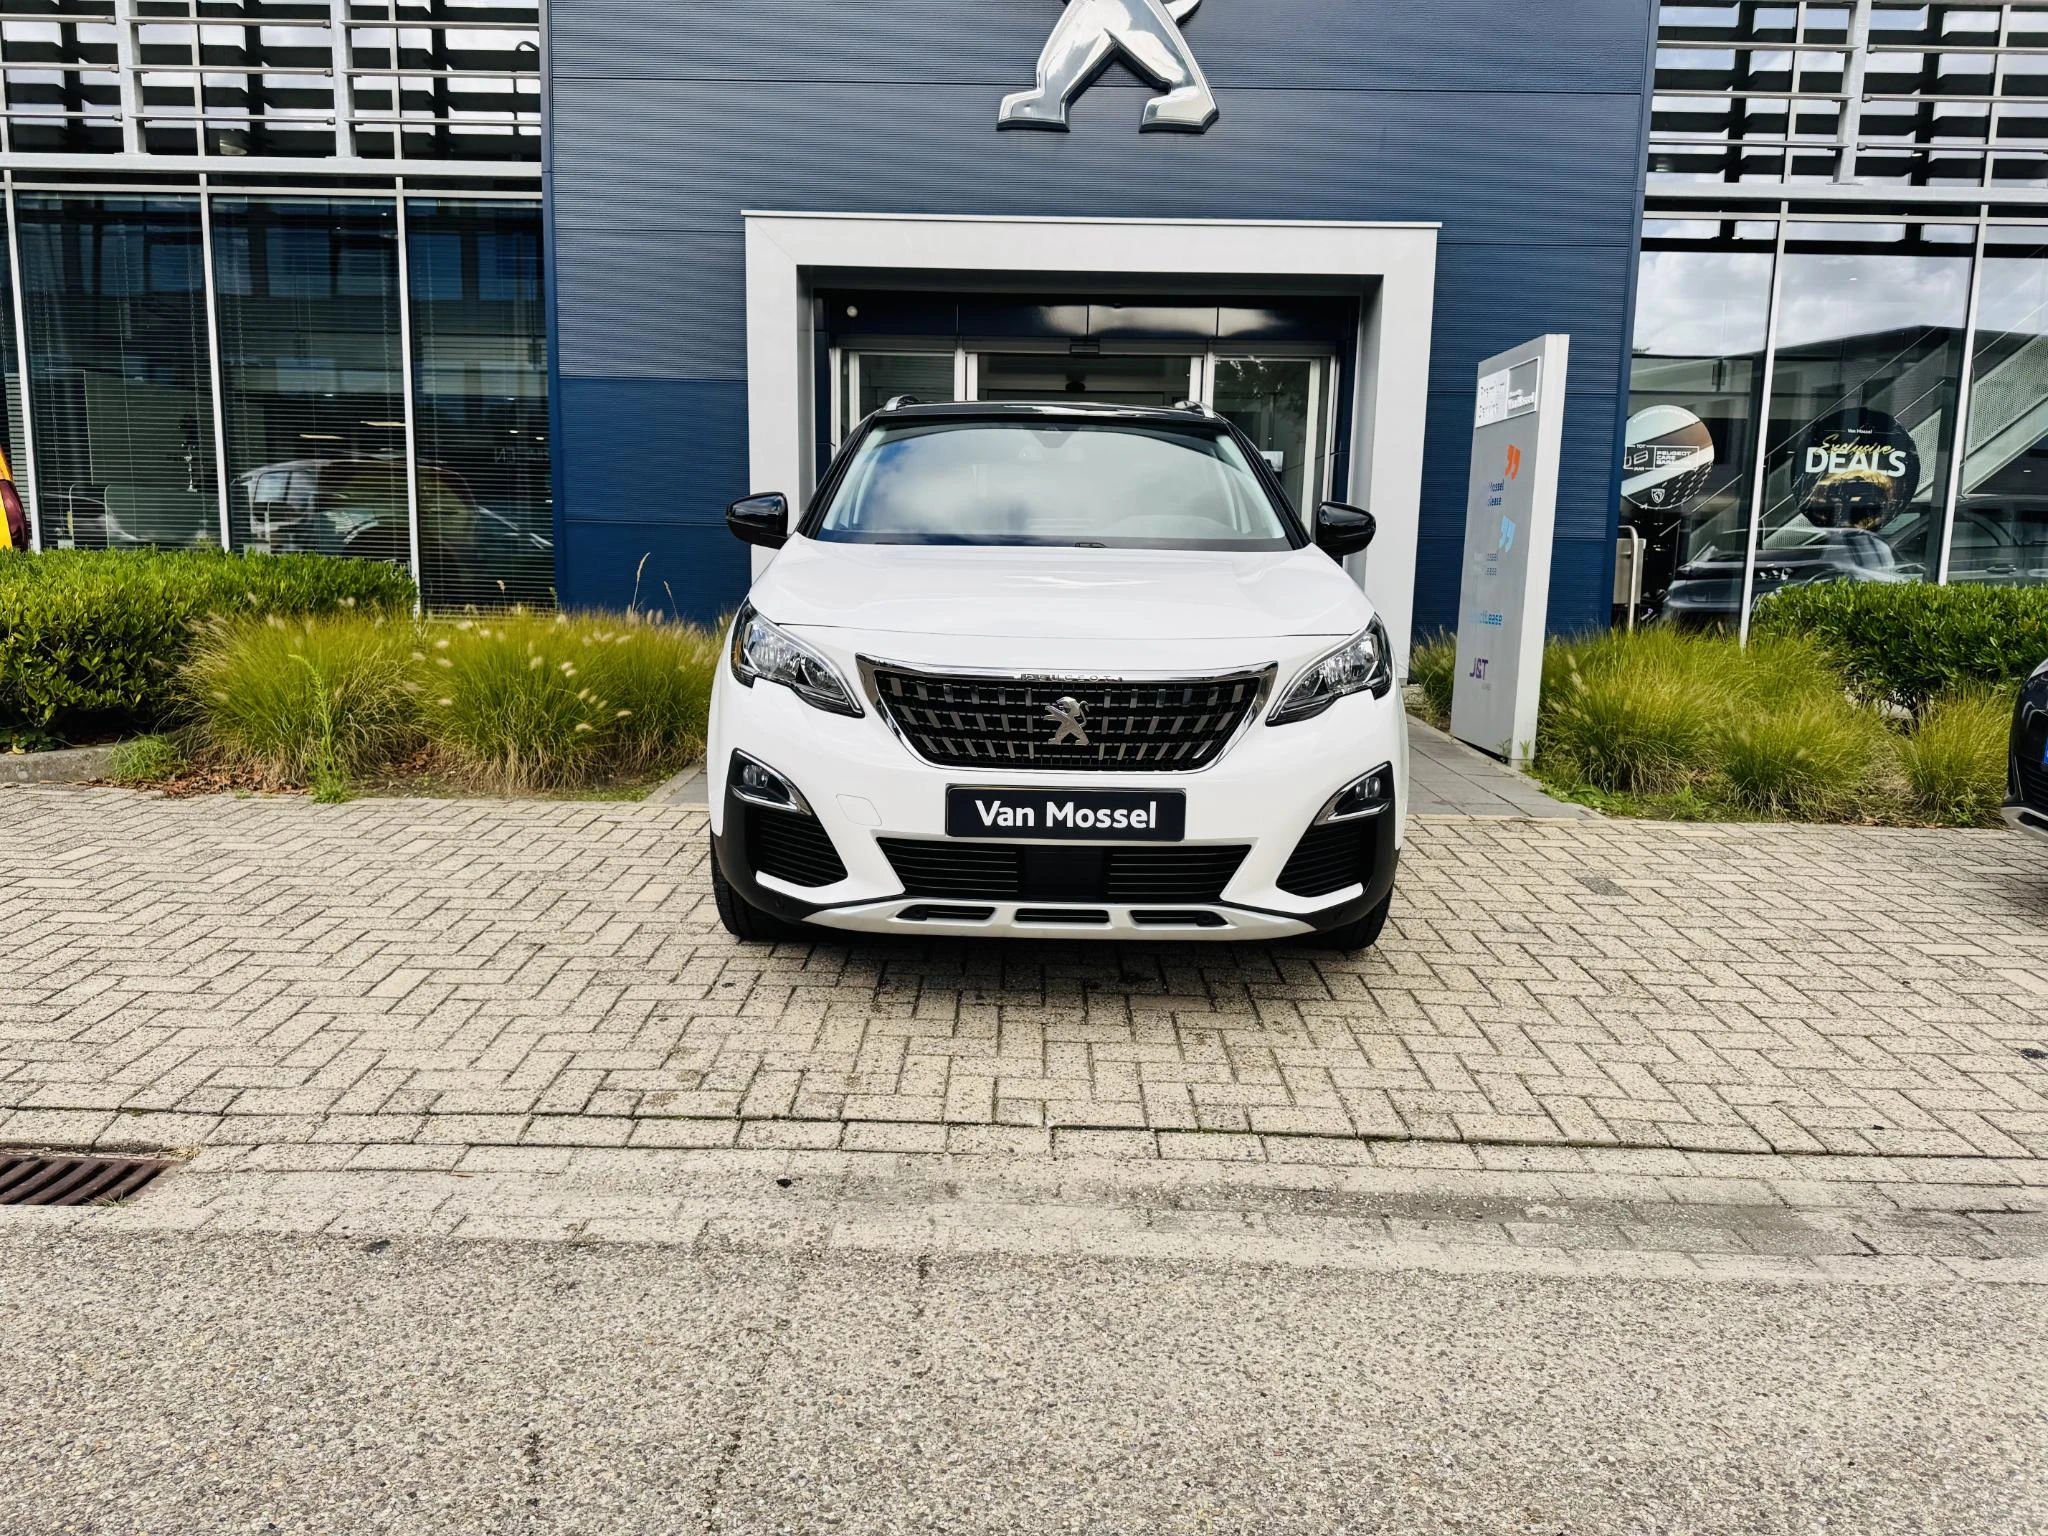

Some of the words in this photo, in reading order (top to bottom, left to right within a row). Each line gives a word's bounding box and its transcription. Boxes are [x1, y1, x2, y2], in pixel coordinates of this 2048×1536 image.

[1813, 433, 1896, 455] Exclusive
[1805, 446, 1907, 478] DEALS
[975, 800, 1035, 828] Van
[1046, 801, 1157, 829] Mossel
